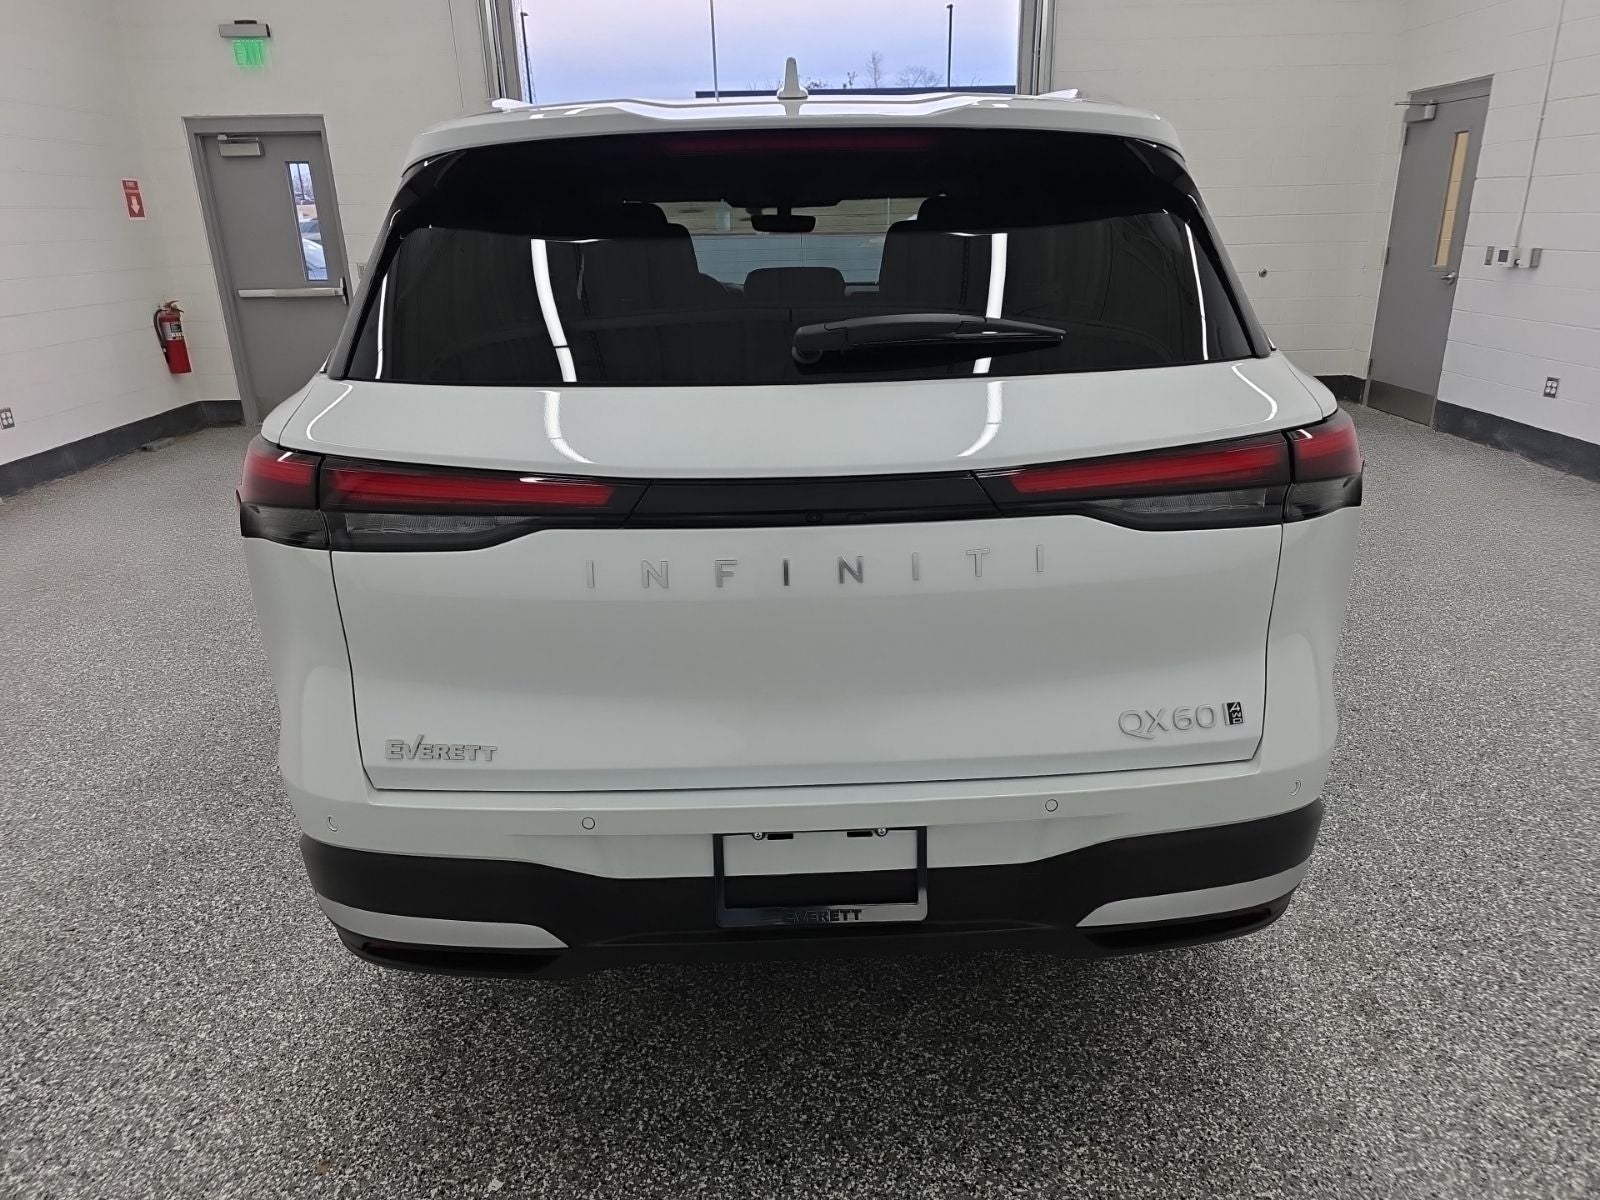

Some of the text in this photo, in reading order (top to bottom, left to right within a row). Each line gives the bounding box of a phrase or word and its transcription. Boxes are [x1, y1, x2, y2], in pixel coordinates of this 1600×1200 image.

[585, 544, 1045, 590] INFINITI
[1118, 703, 1217, 740] QX60
[385, 734, 498, 762] EVERETT
[786, 908, 862, 923] EVERETT
